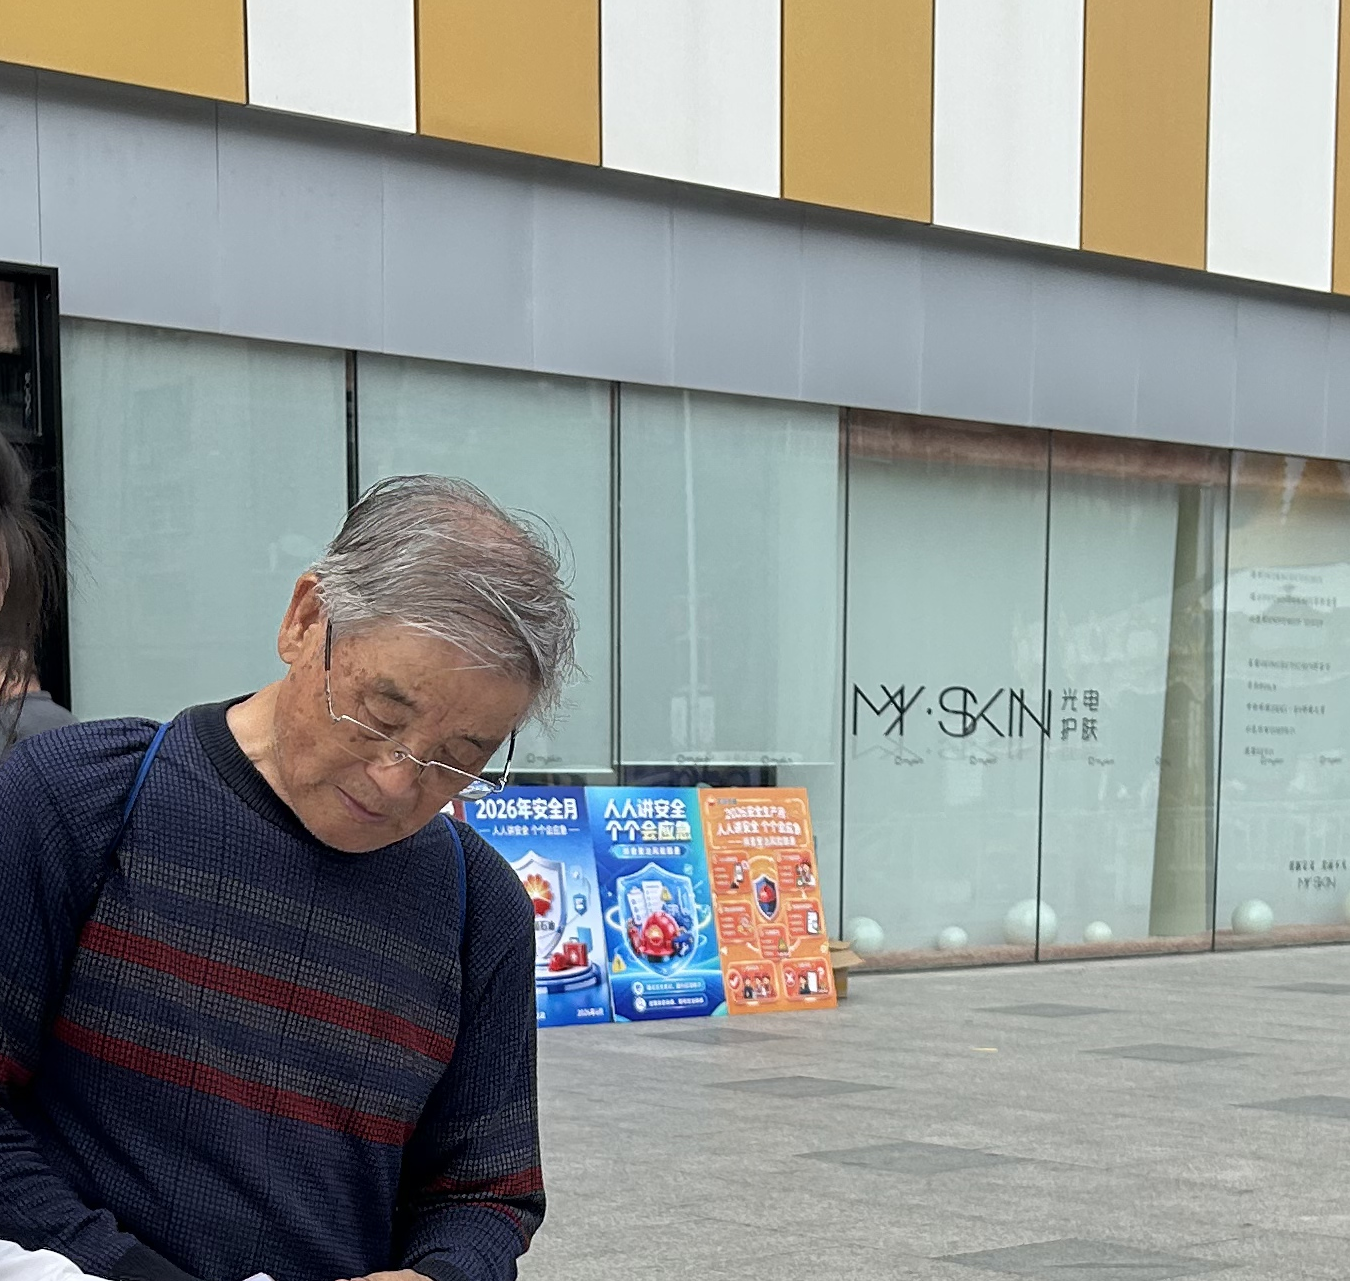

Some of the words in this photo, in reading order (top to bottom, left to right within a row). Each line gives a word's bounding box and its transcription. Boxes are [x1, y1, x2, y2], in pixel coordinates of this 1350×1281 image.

[1061, 687, 1100, 712] 光电
[1061, 716, 1100, 741] 护肤
[475, 797, 579, 822] 2026年安全月
[603, 798, 688, 820] 人人讲安全
[605, 821, 692, 843] 个个会应急
